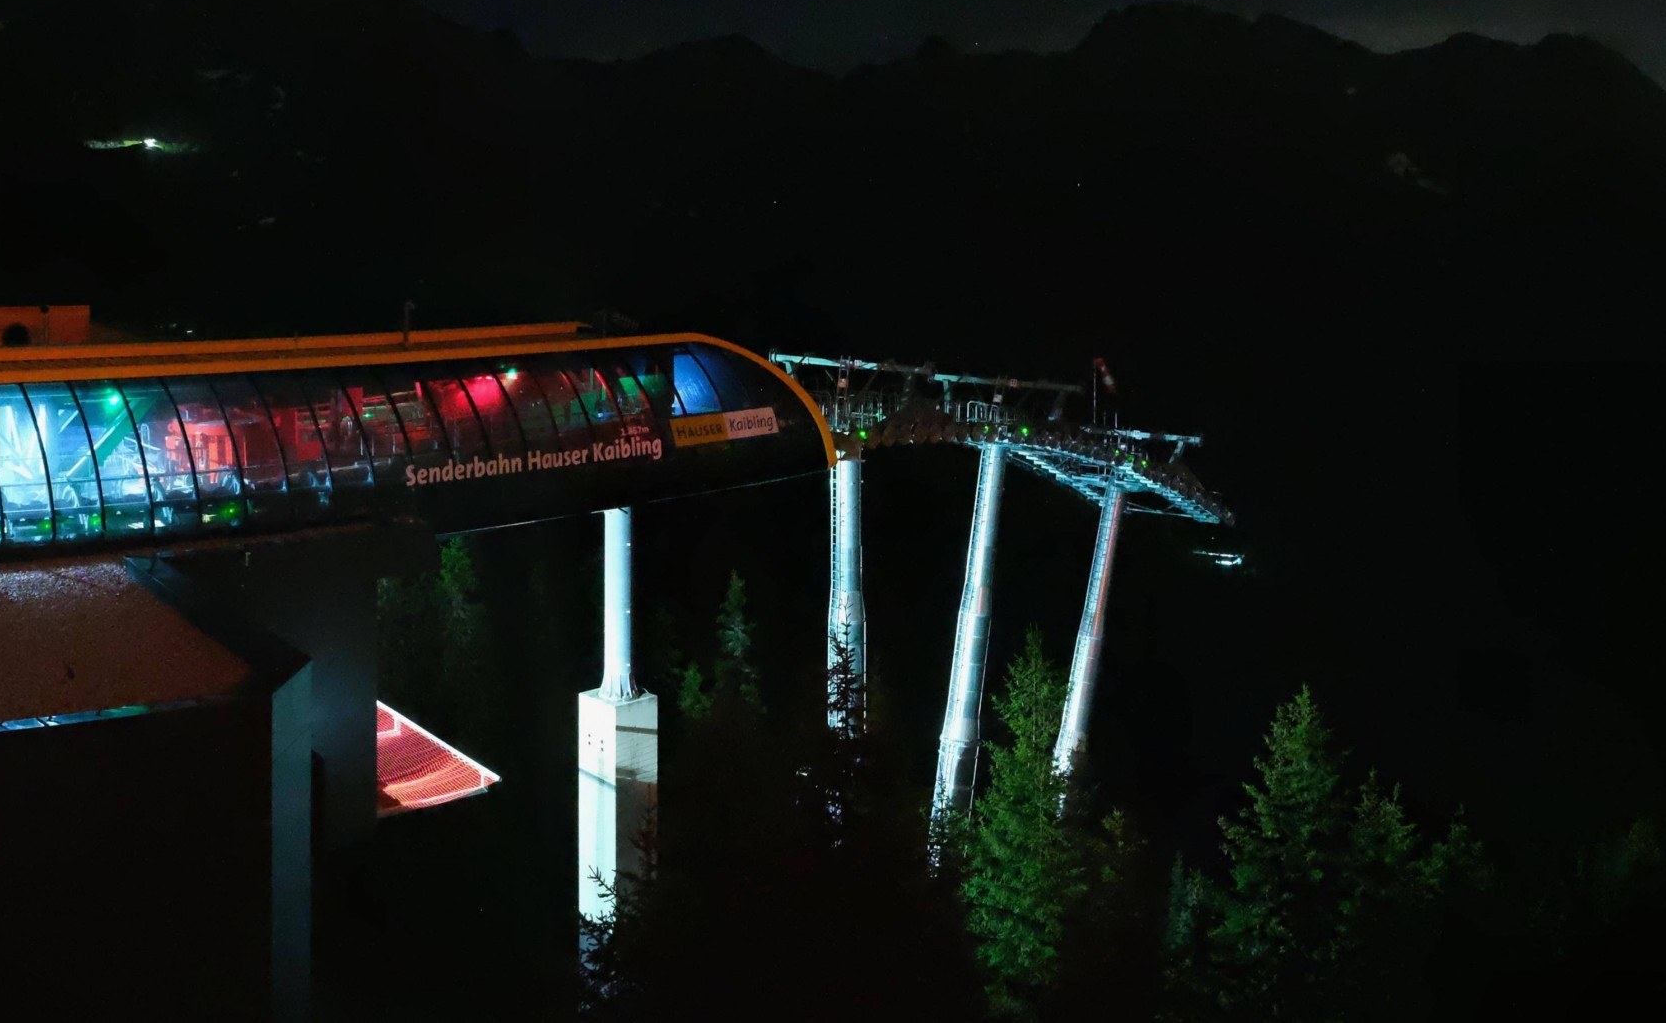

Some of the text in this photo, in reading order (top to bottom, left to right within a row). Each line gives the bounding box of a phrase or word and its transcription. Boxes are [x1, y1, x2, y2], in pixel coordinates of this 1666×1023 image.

[676, 415, 773, 439] HAUSER Kaibling
[405, 436, 663, 487] Senderbahn Hauser Kaibling
